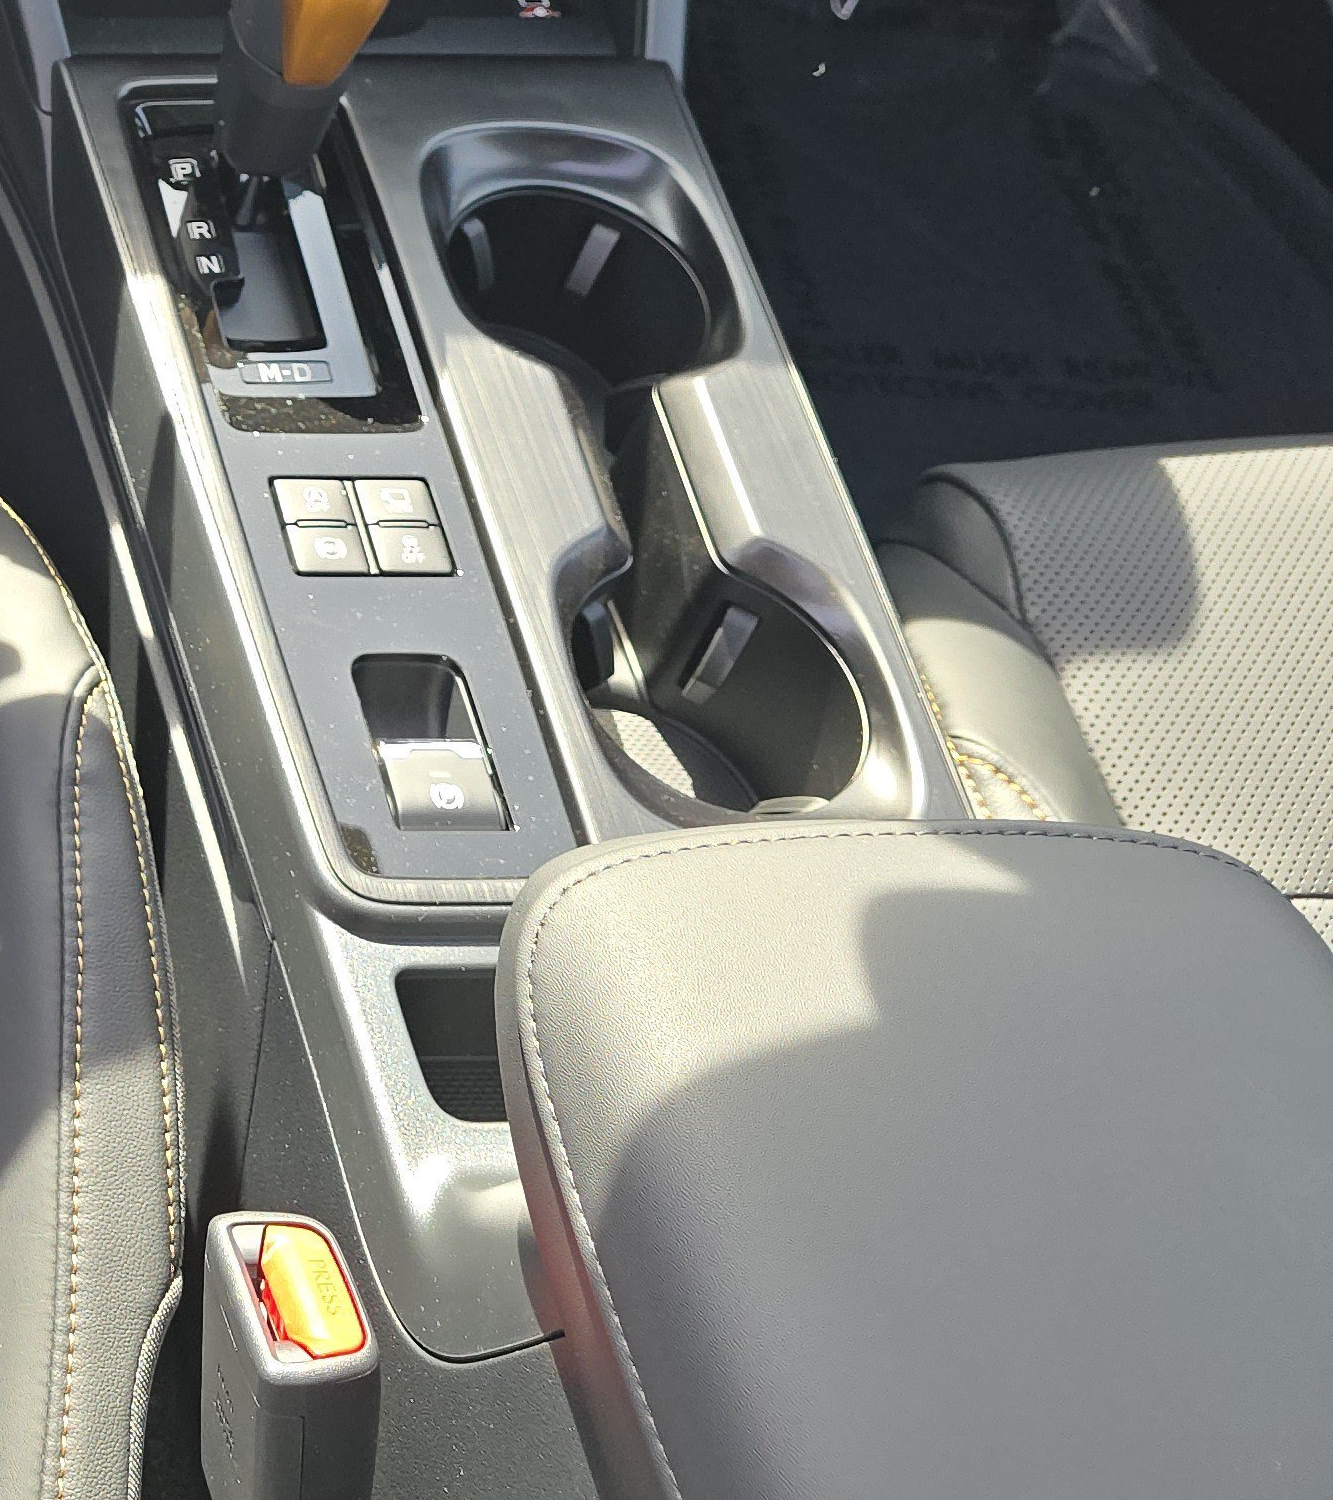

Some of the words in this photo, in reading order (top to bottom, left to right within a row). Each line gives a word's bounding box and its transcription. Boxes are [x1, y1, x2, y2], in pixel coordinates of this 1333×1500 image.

[173, 162, 194, 180] P
[189, 222, 213, 240] R
[199, 256, 221, 273] N
[309, 1260, 341, 1315] PRESS
